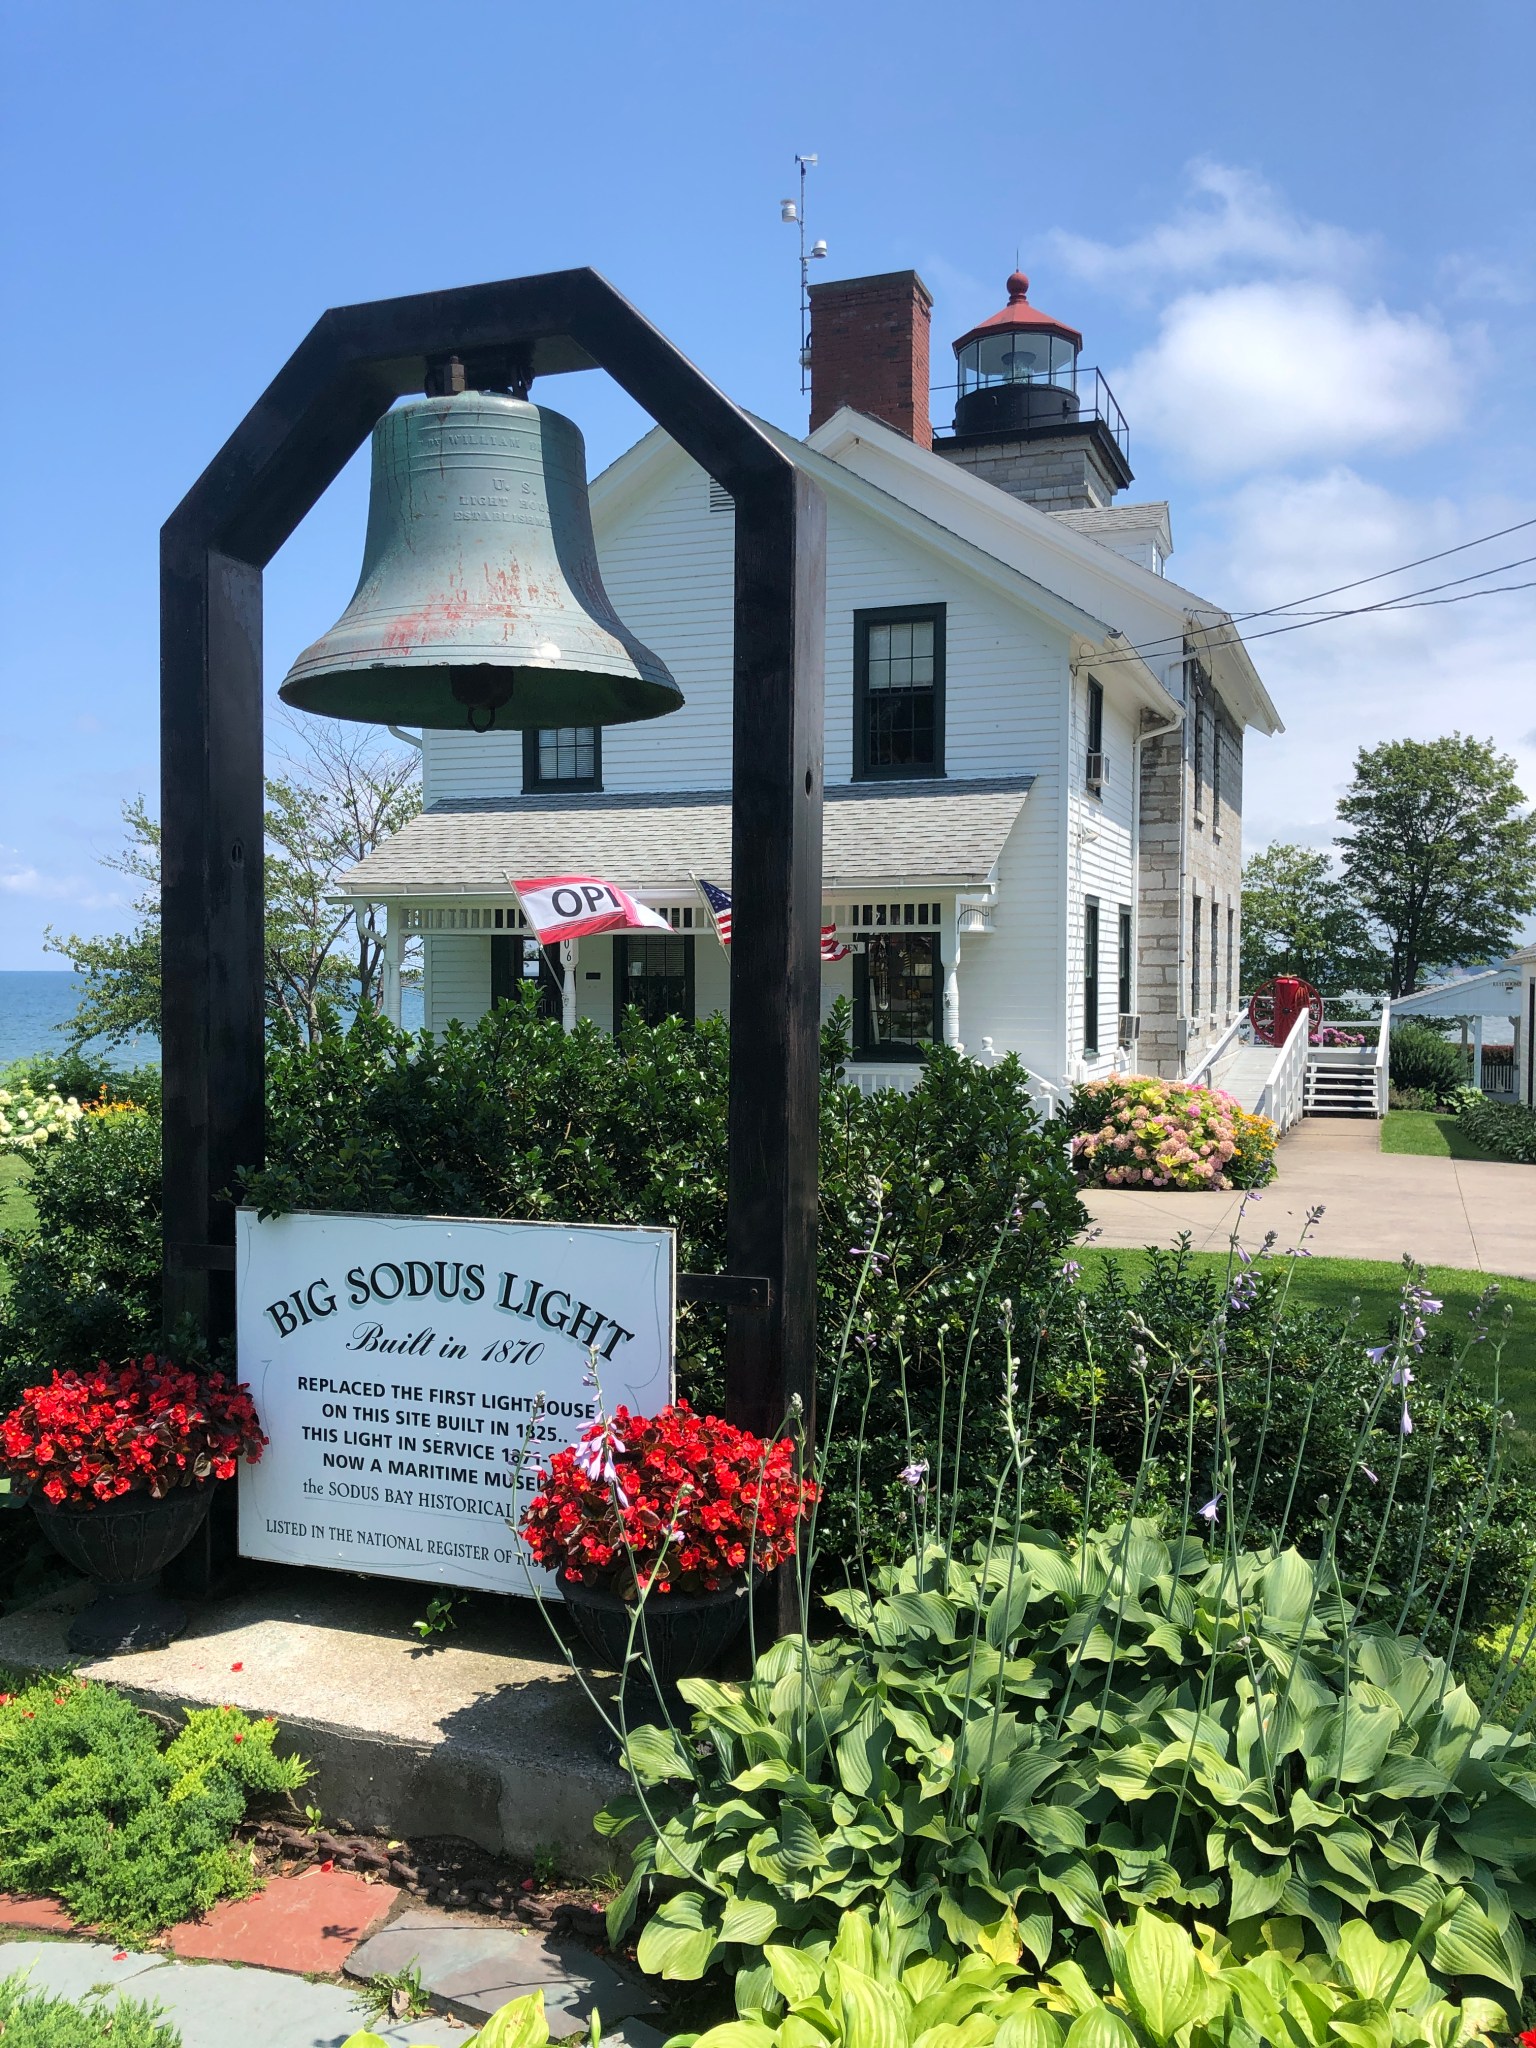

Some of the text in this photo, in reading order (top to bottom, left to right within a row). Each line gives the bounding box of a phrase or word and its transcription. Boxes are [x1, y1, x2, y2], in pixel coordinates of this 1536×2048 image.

[448, 434, 521, 449] WILLIAM
[458, 495, 509, 507] LIGHT
[492, 478, 537, 496] U. S.
[264, 1260, 636, 1362] BIG SODUS LIGHT
[345, 1321, 546, 1366] Built in 1870
[297, 1376, 386, 1398] REPLACED
[391, 1384, 424, 1402] THE
[429, 1388, 476, 1407] FIRST
[322, 1403, 347, 1419] ON
[352, 1406, 390, 1423] THIS
[395, 1410, 432, 1428] SITE
[437, 1414, 485, 1434] BUILT
[490, 1420, 509, 1438] IN
[302, 1425, 338, 1443] THIS
[344, 1430, 393, 1449] LIGHT
[398, 1436, 416, 1452] IN
[422, 1438, 495, 1461] SERVICE
[323, 1452, 365, 1471] NOW
[369, 1458, 383, 1473] A
[388, 1460, 479, 1485] MARITIME
[302, 1477, 324, 1495] the
[328, 1481, 380, 1501] SODUS
[384, 1488, 414, 1506] BAY
[418, 1492, 514, 1519] HISTORICAL
[265, 1519, 308, 1537] LISTED
[311, 1525, 325, 1539] IN
[328, 1526, 354, 1543] THE
[356, 1530, 424, 1553] NATIONAL
[427, 1539, 490, 1562] REGISTER
[493, 1548, 513, 1564] OF
